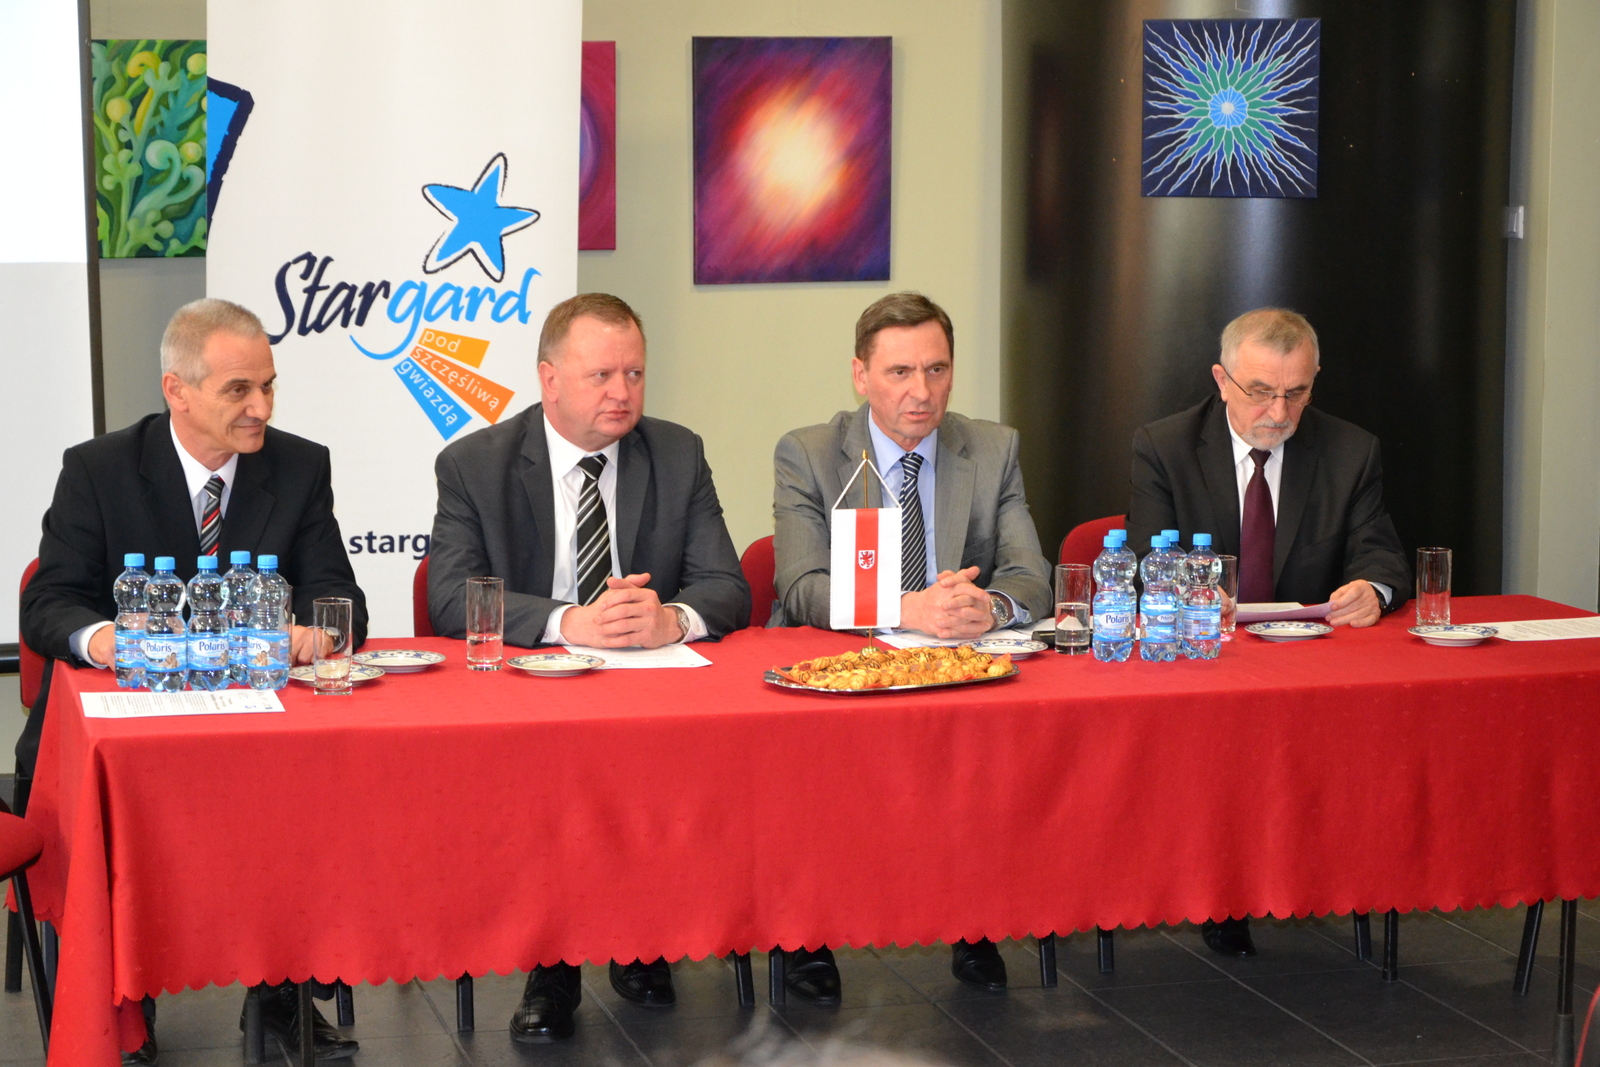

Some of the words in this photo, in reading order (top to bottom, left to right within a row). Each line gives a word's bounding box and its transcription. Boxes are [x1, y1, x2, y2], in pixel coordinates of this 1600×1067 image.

[267, 251, 542, 360] Stargard
[421, 330, 462, 353] pod
[396, 359, 459, 426] gwiazdą
[412, 347, 501, 412] szczęśliwą
[146, 641, 172, 652] Polaris
[198, 641, 226, 651] Polaris
